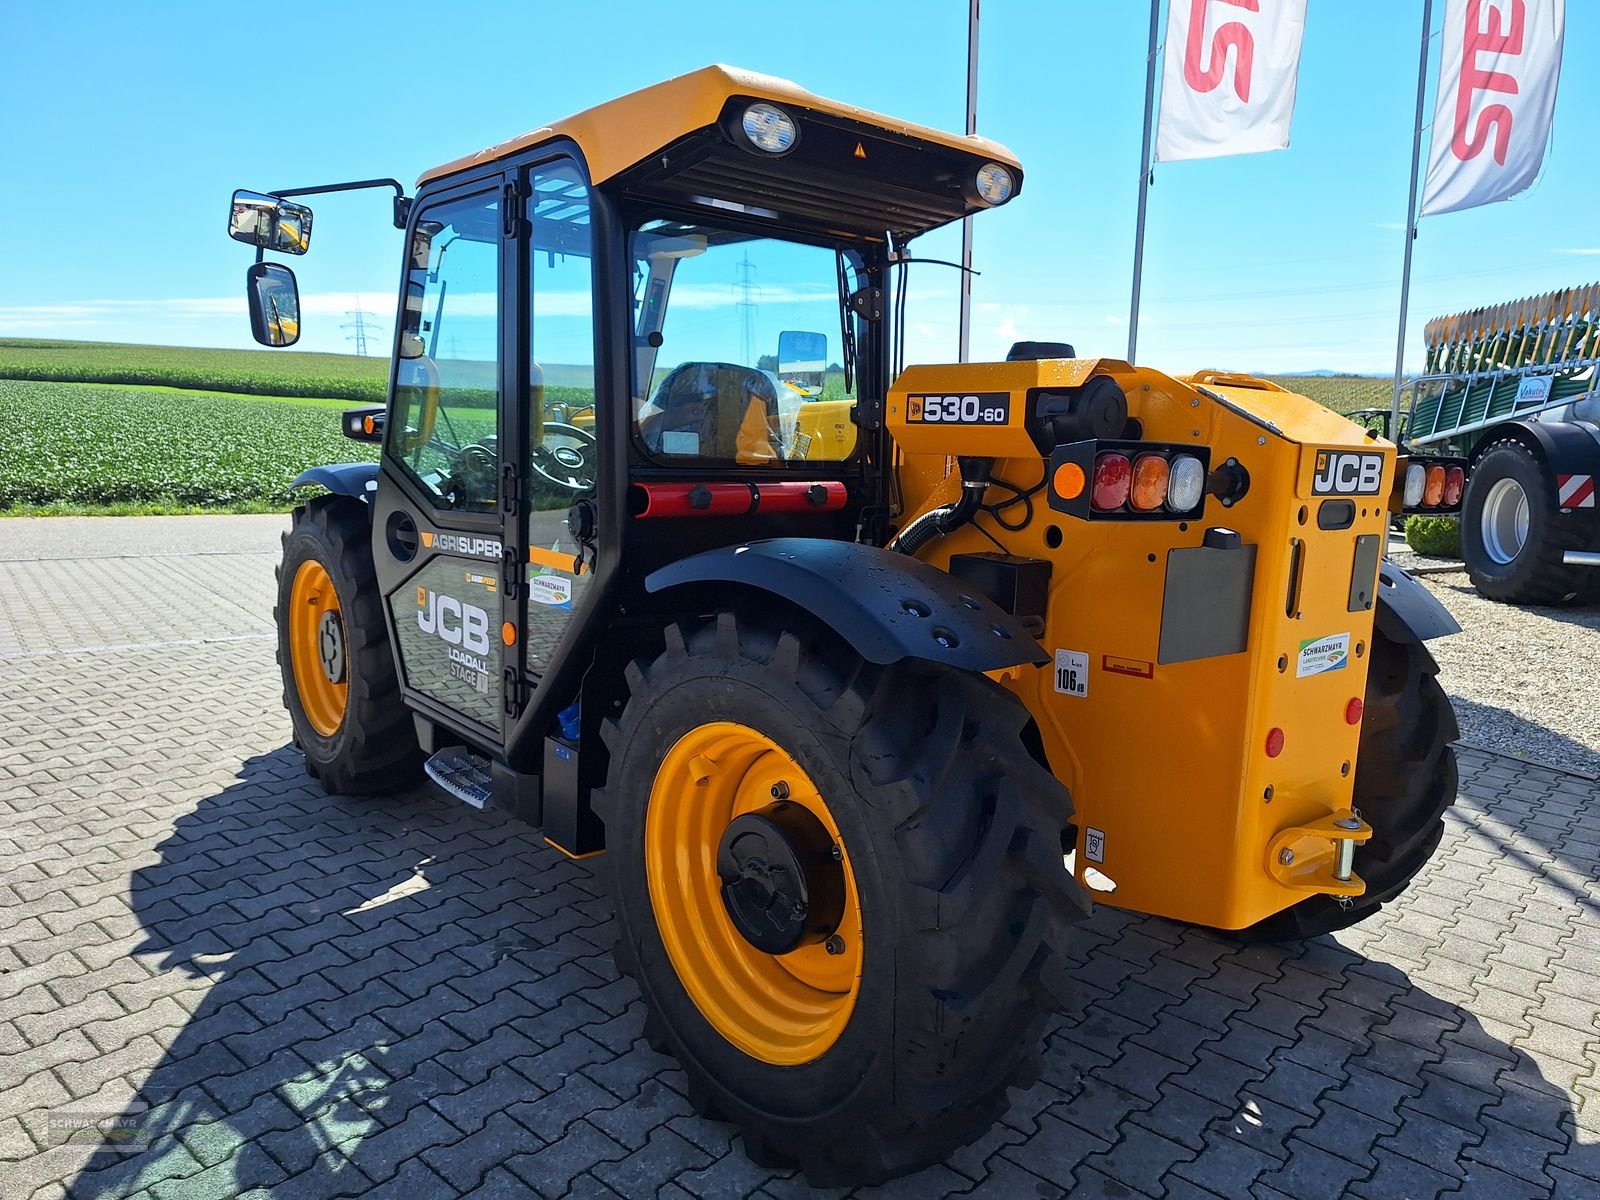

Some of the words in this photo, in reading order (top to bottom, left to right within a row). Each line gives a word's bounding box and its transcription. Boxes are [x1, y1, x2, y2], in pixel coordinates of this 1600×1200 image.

[1451, 0, 1526, 167] STE
[924, 396, 1005, 422] 530-60
[1314, 454, 1382, 493] JCB
[432, 533, 503, 558] AGRISUPER
[533, 578, 565, 592] SCHWARZMAYR
[417, 590, 490, 656] JCB
[448, 646, 489, 675] LOADALL
[1303, 642, 1343, 657] SCHWARZMAYR
[450, 662, 477, 687] STAGE
[1057, 667, 1077, 691] 106
